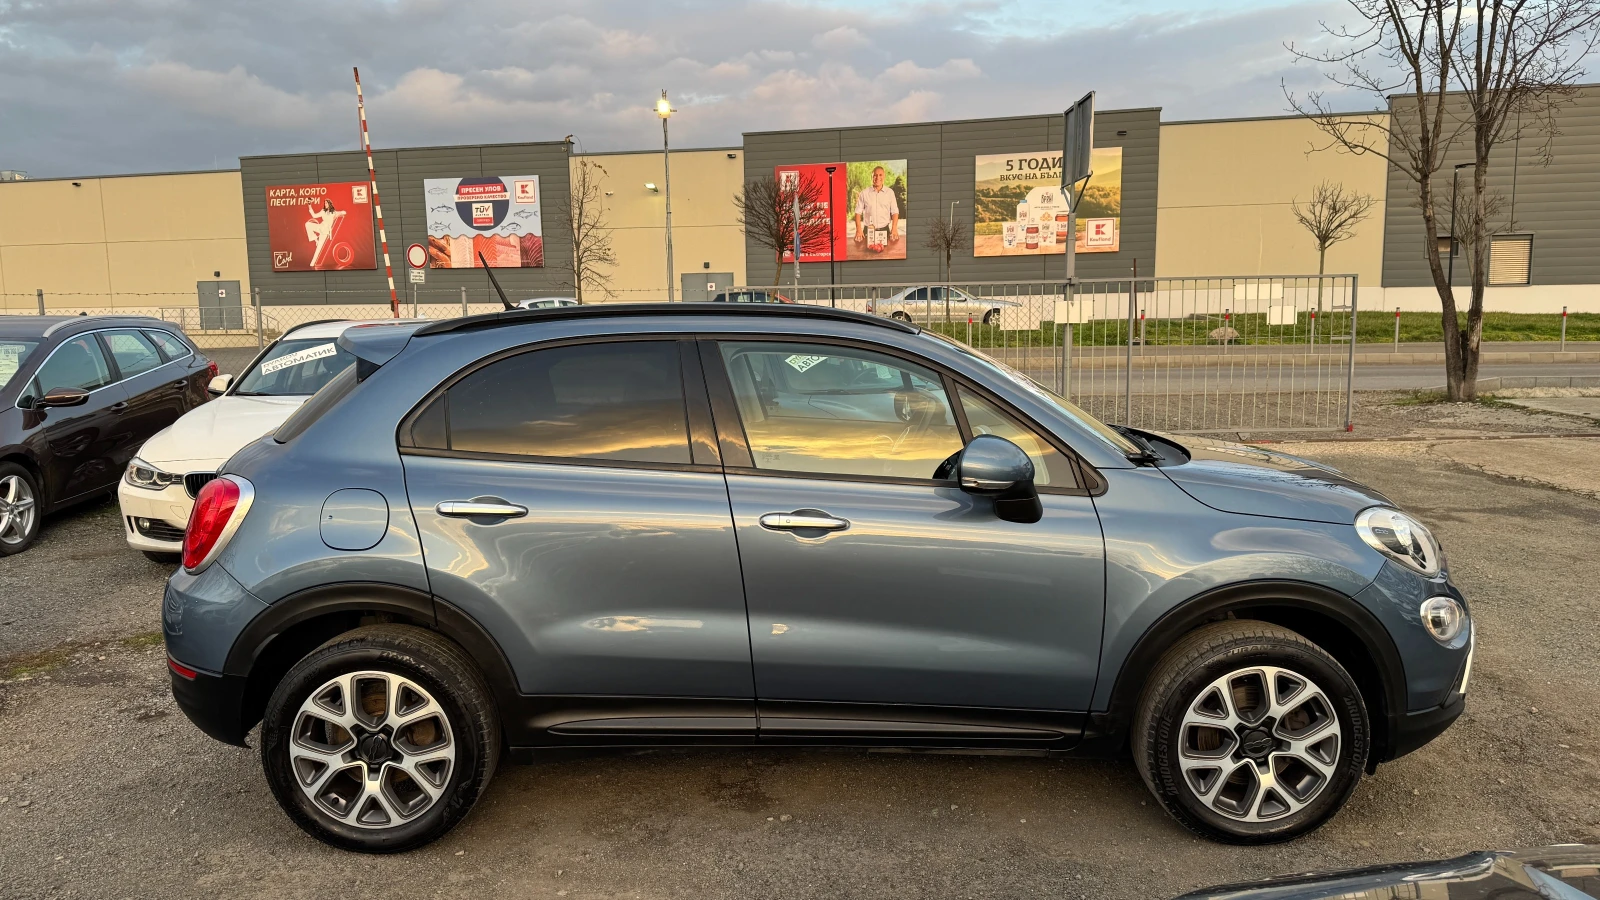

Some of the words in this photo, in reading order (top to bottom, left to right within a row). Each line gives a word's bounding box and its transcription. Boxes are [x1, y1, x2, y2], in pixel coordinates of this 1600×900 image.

[1005, 159, 1014, 172] 5
[1018, 156, 1063, 172] ГОДИ
[1000, 173, 1023, 181] ВКУС
[1025, 172, 1038, 180] НА
[1040, 171, 1062, 179] БЪЛГ
[269, 188, 298, 197] КАРТА,
[299, 187, 327, 196] КОЯТО
[461, 186, 484, 194] ПРЕСЕН
[270, 198, 296, 207] ПЕСТИ
[298, 196, 320, 206] ПАРИ
[264, 347, 335, 375] АВТОМАТИК
[1343, 694, 1364, 777] BRIDGESTONE
[1157, 711, 1180, 796] BRIDGESTONE
